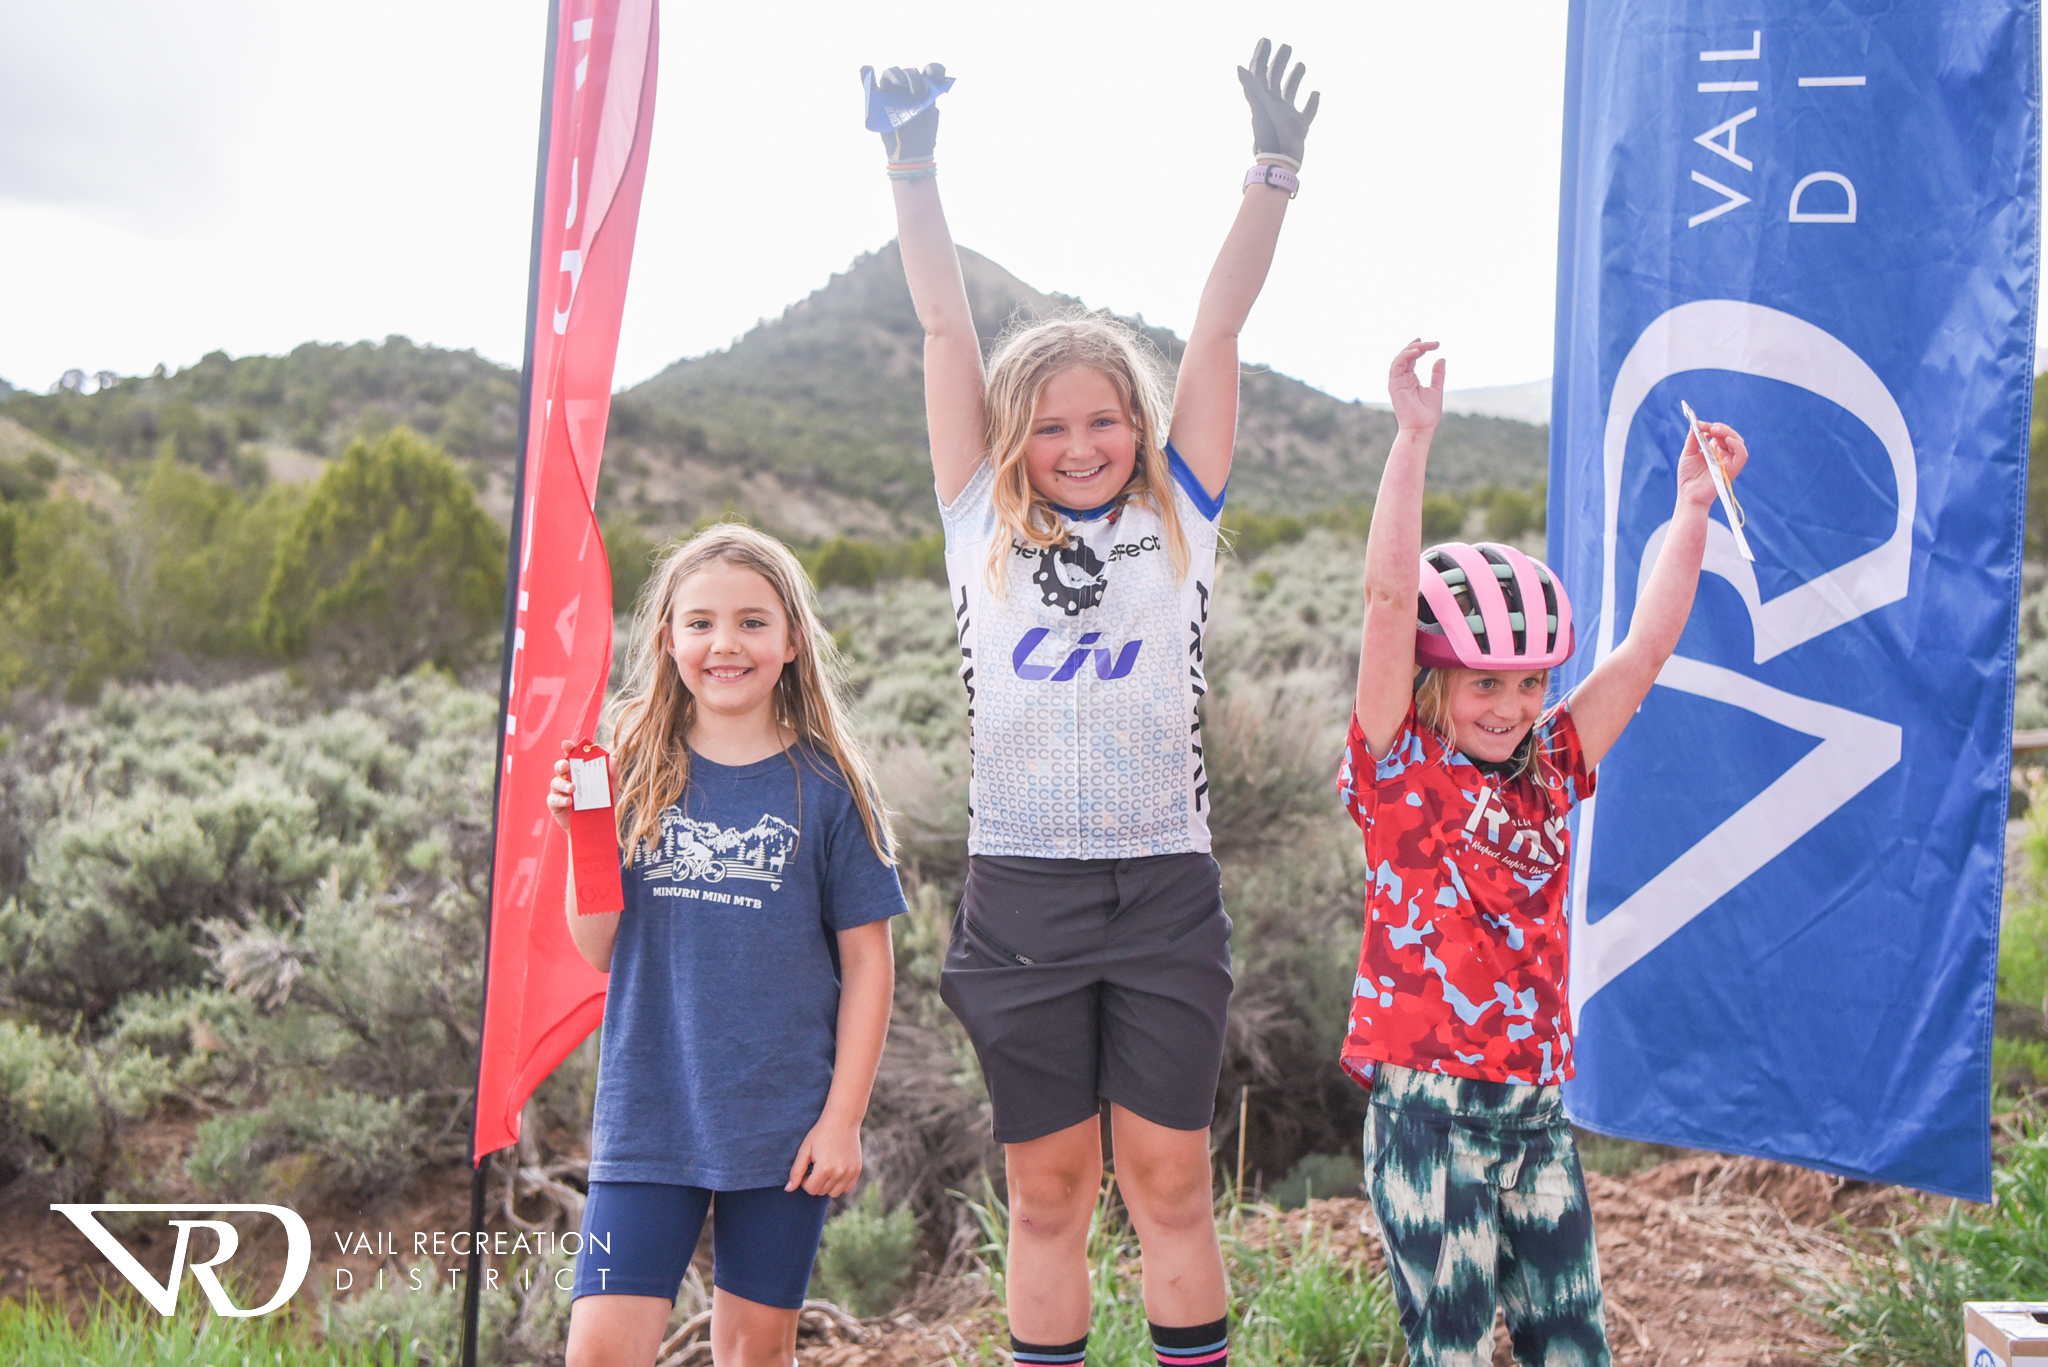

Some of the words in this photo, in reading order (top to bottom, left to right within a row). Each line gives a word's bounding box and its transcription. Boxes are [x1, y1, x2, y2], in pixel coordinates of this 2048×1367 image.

[1688, 30, 1761, 228] VAIL
[653, 887, 700, 899] MINURN
[702, 890, 731, 904] MINI
[733, 895, 762, 909] MTB
